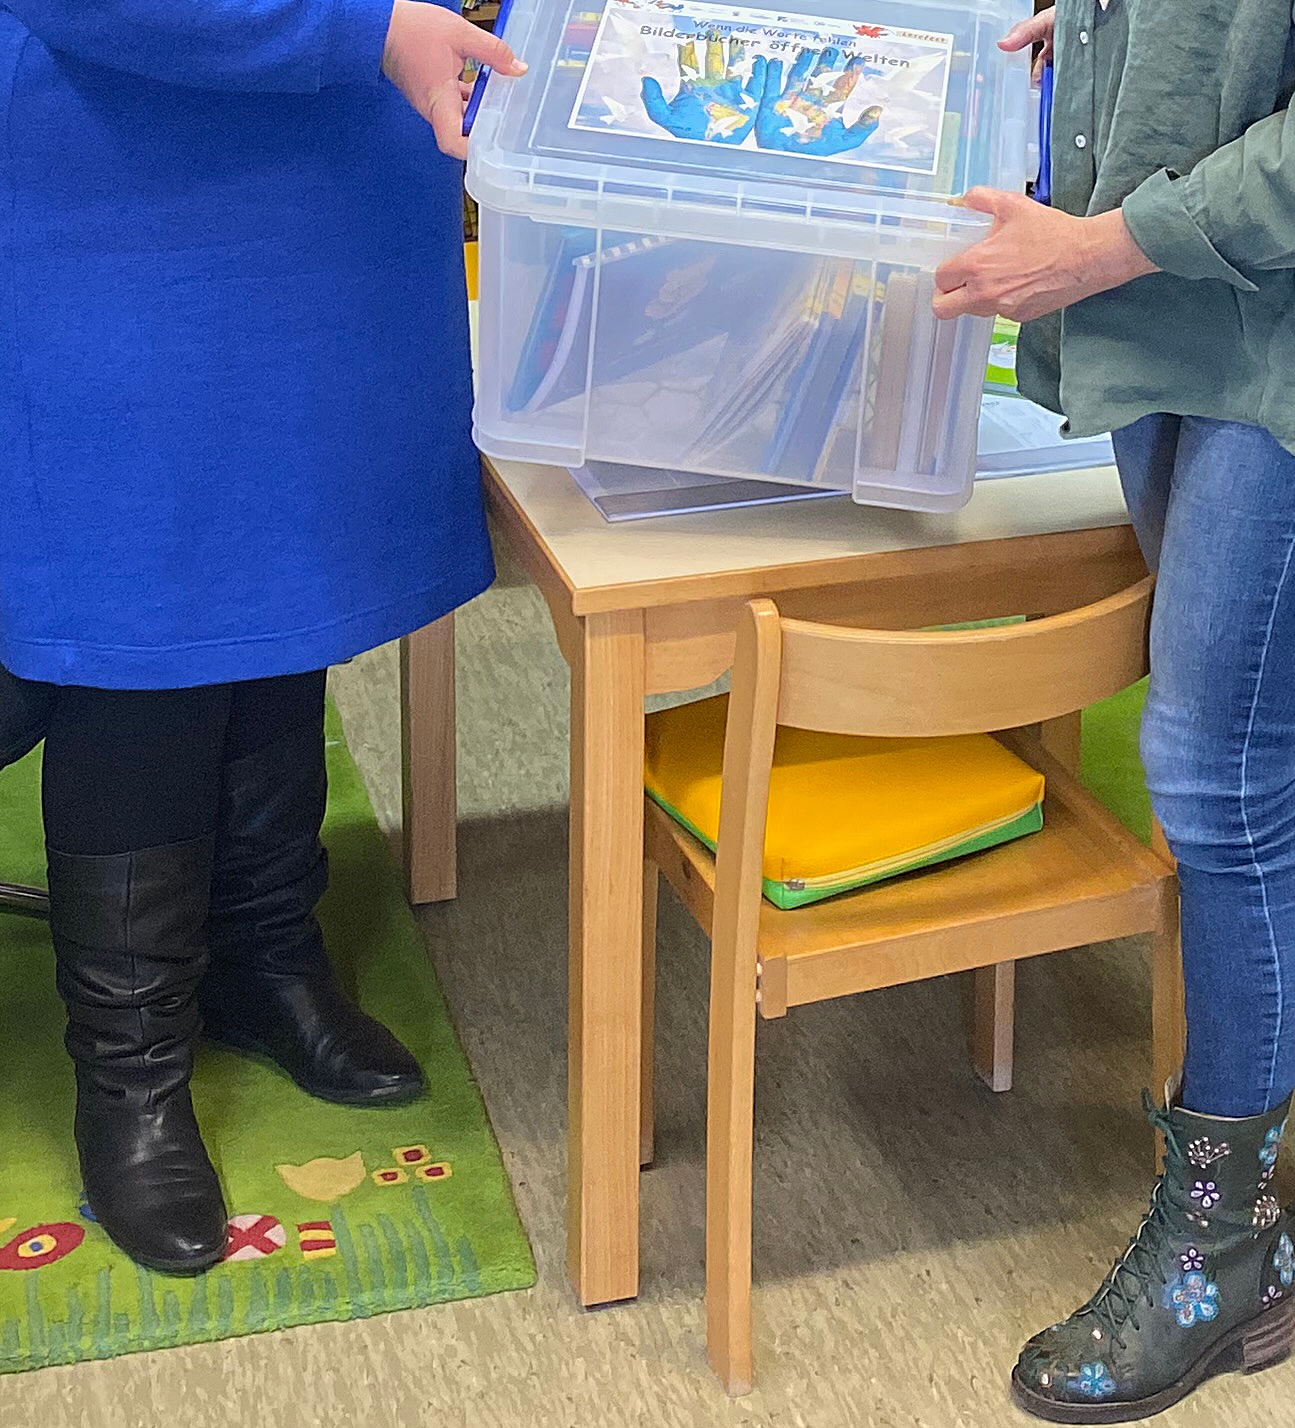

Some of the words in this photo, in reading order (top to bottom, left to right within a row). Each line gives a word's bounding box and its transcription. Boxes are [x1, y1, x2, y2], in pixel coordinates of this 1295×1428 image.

[640, 25, 762, 49] Bilderbücher
[768, 40, 833, 57] öffnen
[842, 51, 910, 69] Welten
[692, 20, 733, 33] Wenn
[735, 23, 757, 35] die
[762, 27, 808, 41] Worte
[812, 33, 857, 48] fehlen
